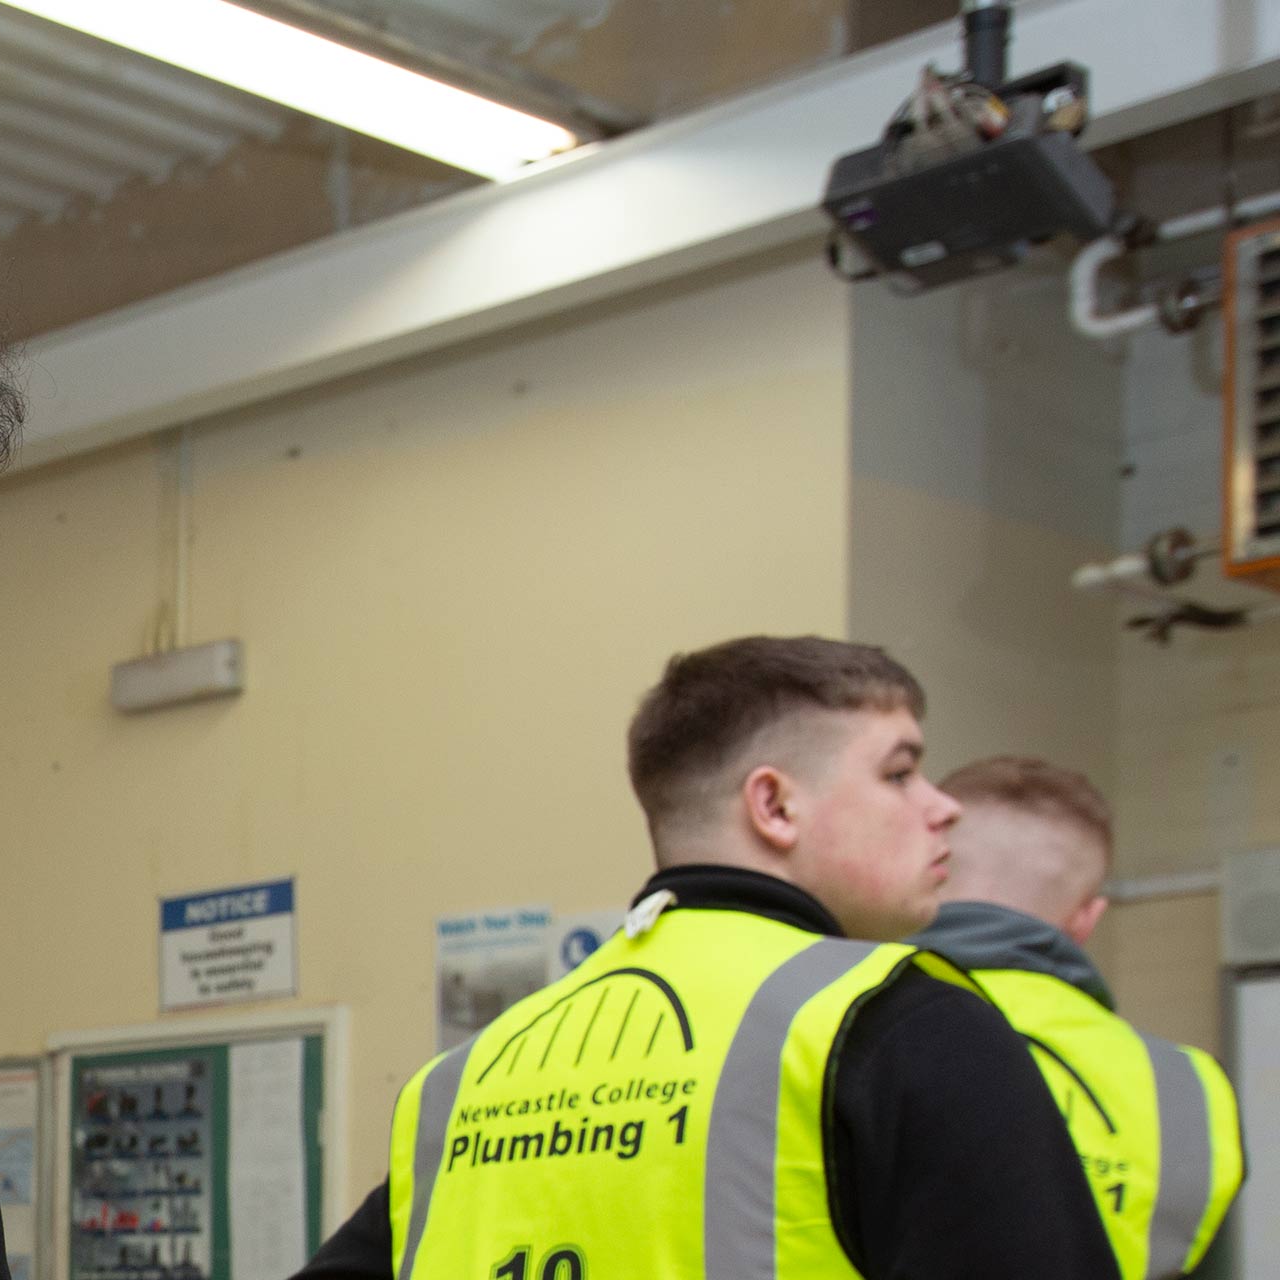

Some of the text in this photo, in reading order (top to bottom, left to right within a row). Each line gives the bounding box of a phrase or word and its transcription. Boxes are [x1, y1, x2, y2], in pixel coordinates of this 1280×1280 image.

[184, 889, 271, 924] NOTICE
[456, 1078, 698, 1127] Newcastle College
[446, 1104, 690, 1172] Plumbing 1
[1105, 1183, 1126, 1213] 1
